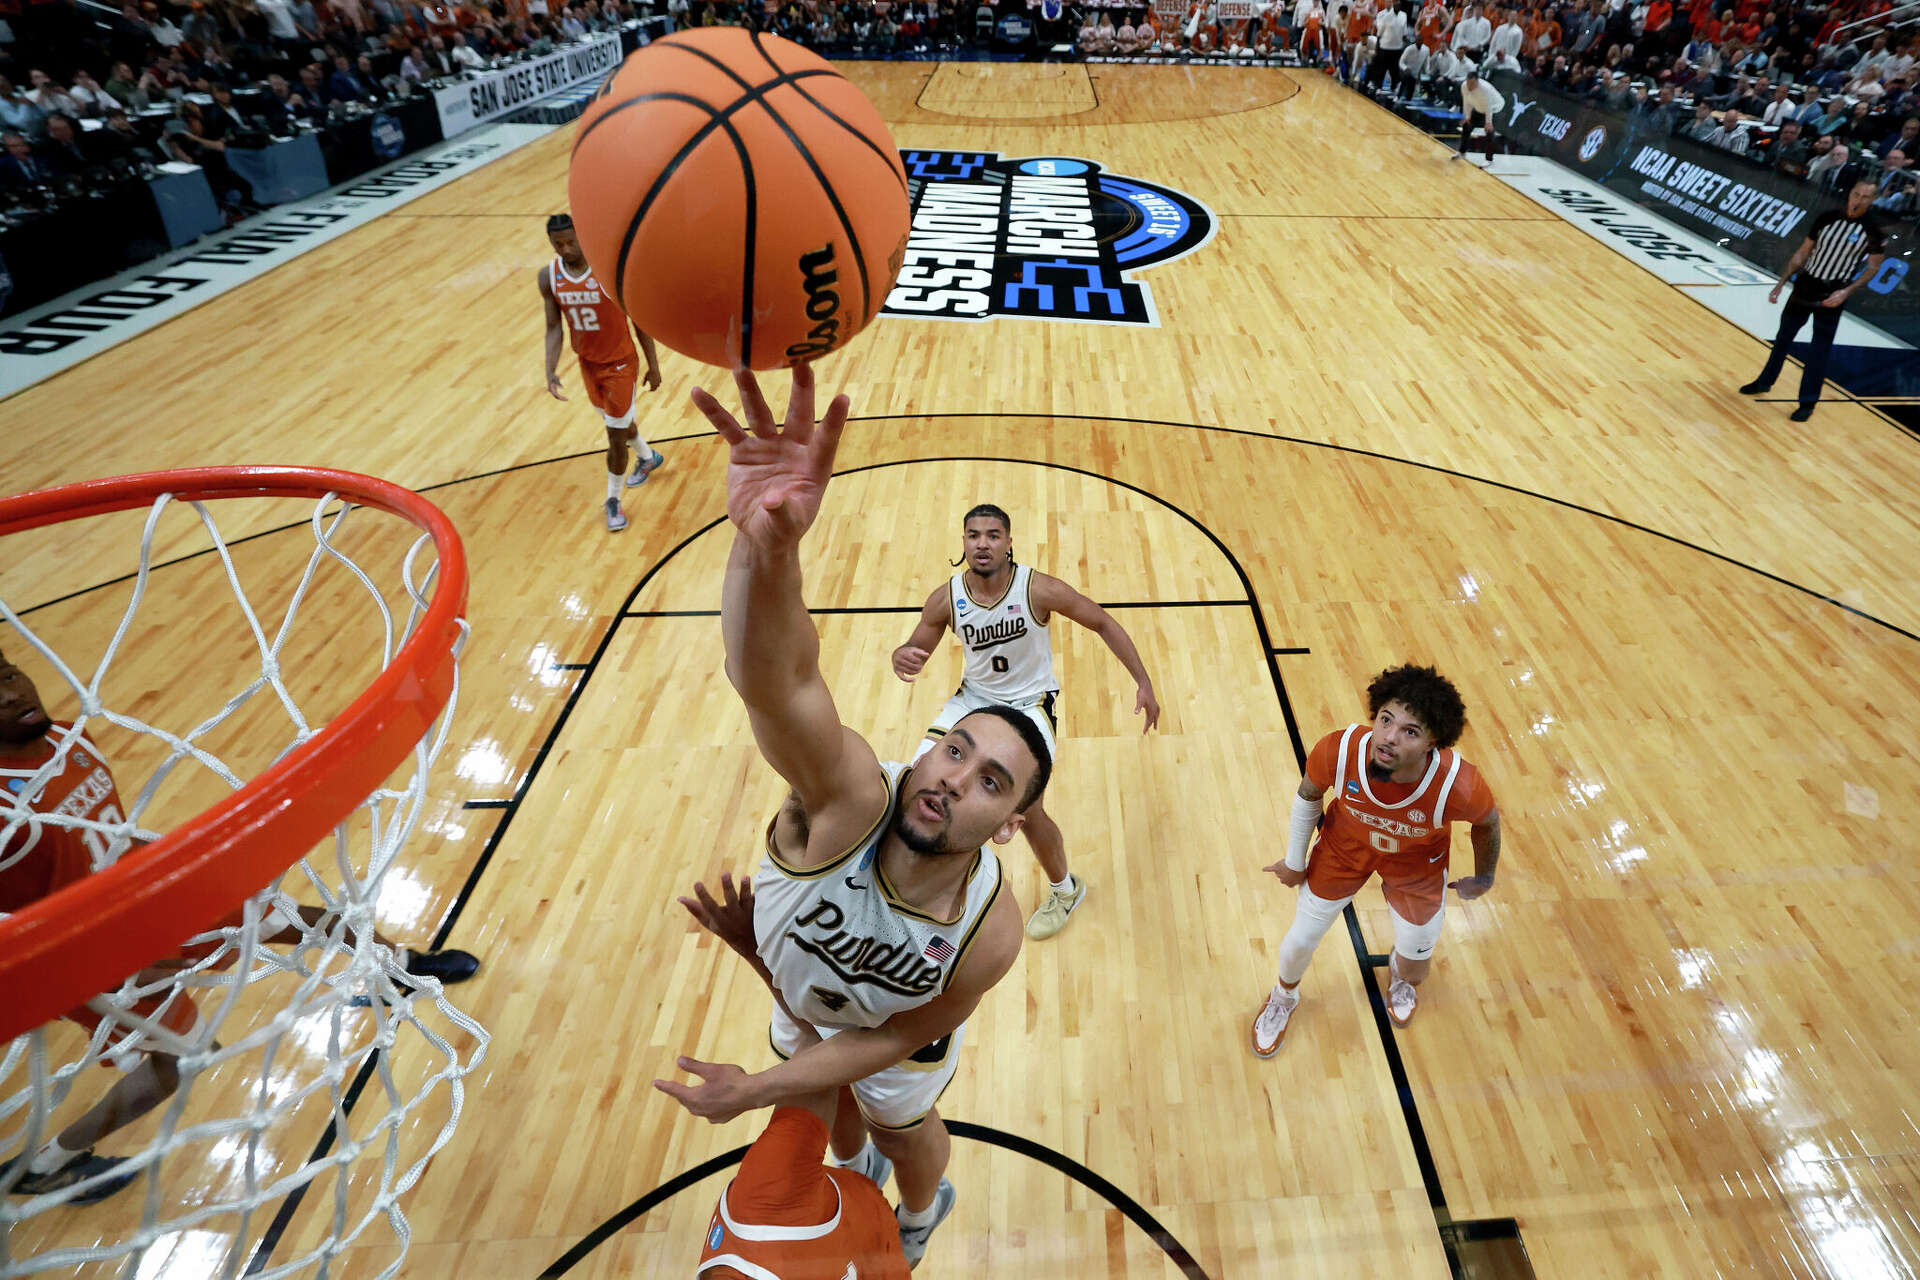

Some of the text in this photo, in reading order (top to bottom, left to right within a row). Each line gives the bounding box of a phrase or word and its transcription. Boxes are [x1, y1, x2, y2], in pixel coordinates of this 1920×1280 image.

[1220, 3, 1251, 15] DEFENSE
[470, 80, 501, 118] SAN
[502, 68, 535, 107] JOSE
[534, 57, 569, 94] STATE
[567, 38, 621, 81] UNIVERSITY
[1537, 112, 1571, 141] TEXAS
[335, 161, 459, 198] ROAD
[1630, 146, 1807, 238] NCAA SWEET SIXTEEN
[1006, 175, 1100, 257] MARCH
[1129, 193, 1181, 221] SWEET
[1538, 187, 1715, 263] SAN JOSE
[1712, 214, 1753, 240] UNIVERSITY
[885, 182, 1002, 313] MADNESS
[0, 212, 348, 355] FINAL FOUR
[558, 291, 600, 305] TEXAS
[568, 307, 600, 331] 12
[962, 617, 1028, 652] Purdue
[992, 656, 1009, 673] 0
[1344, 804, 1430, 838] TEXAS
[1369, 831, 1400, 853] 0
[785, 896, 942, 996] Purdue
